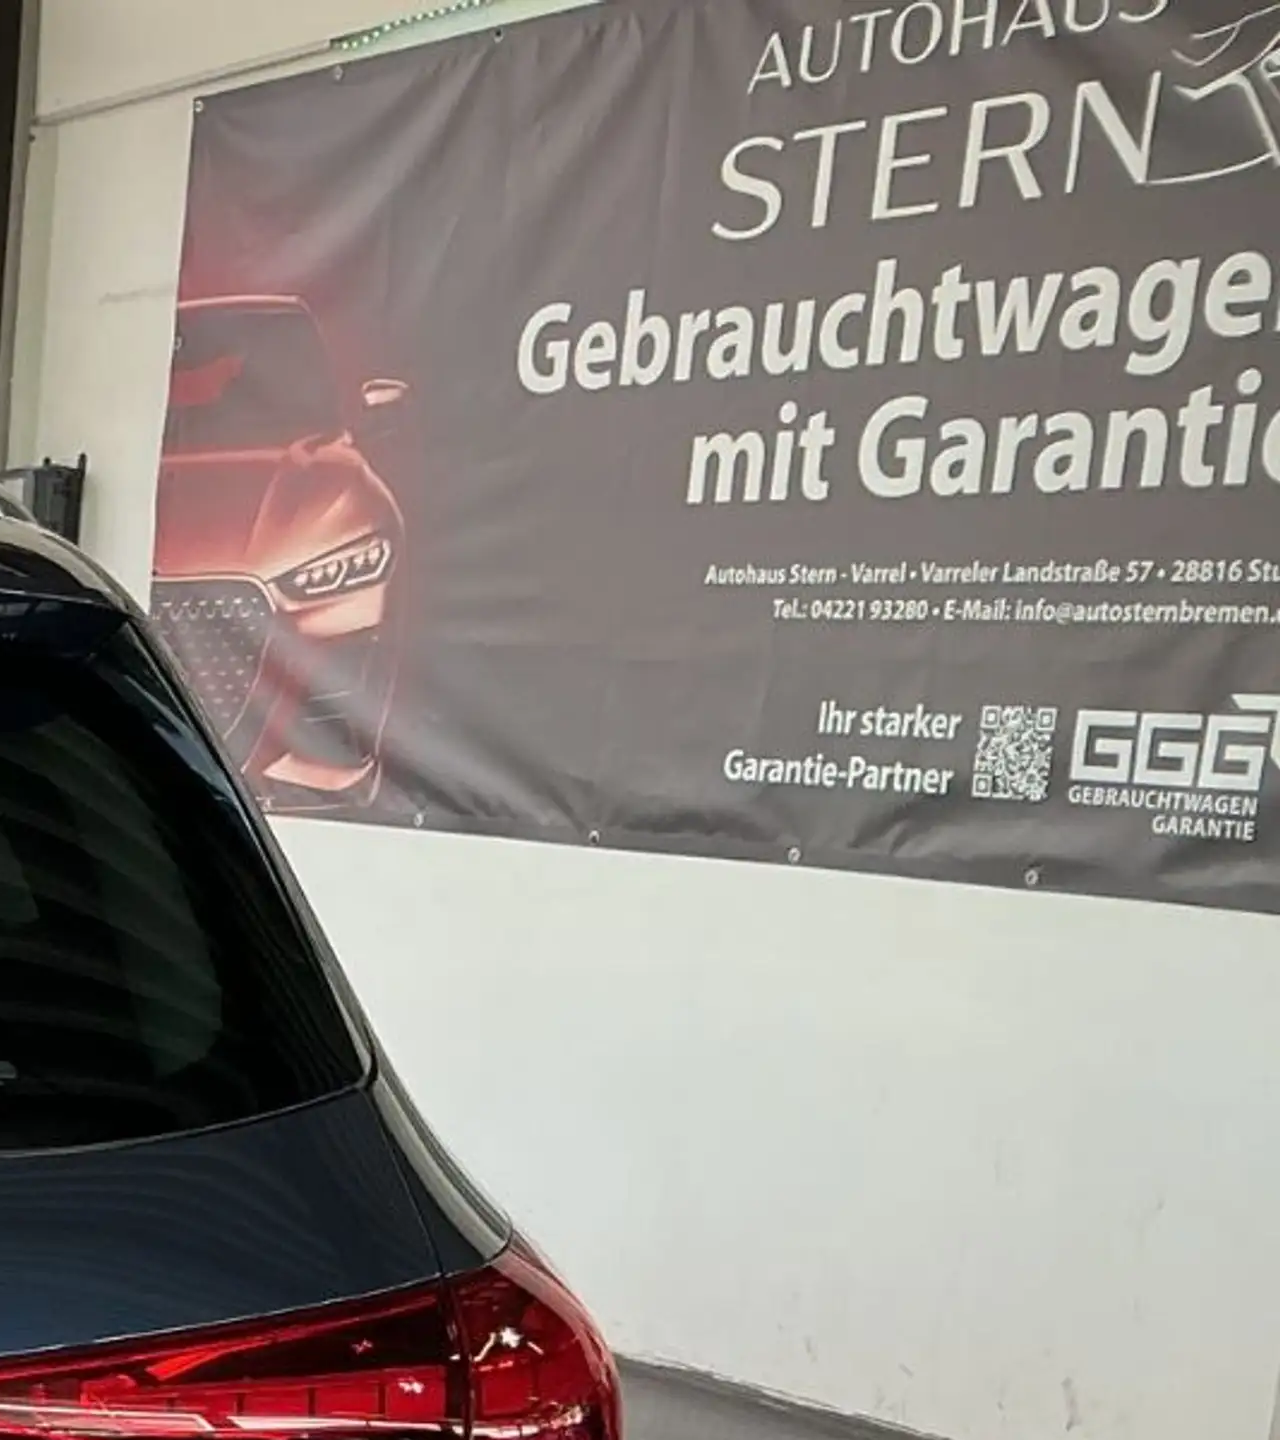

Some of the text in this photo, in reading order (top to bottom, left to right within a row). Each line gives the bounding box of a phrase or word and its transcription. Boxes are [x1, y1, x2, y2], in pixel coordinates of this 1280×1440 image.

[711, 71, 1161, 241] STERN
[517, 250, 1280, 394] Gebrauchtwage
[686, 401, 835, 504] mit
[704, 564, 786, 585] Autohaus
[790, 563, 837, 584] Stern
[851, 562, 907, 584] Varrel
[921, 561, 998, 584] Varreler
[1002, 559, 1120, 582] Landstraße
[1125, 561, 1154, 582] 57
[1170, 559, 1243, 582] 28816
[811, 600, 864, 620] 04221
[870, 600, 928, 620] 93280
[944, 599, 1010, 621] E-Mail:
[1015, 598, 1280, 624] info@autosternbremen.
[818, 700, 962, 740] Ihr starker
[1070, 708, 1273, 791] GGG
[724, 749, 954, 795] Garantie-Partner
[1068, 785, 1258, 817] GEBRAUCHTWAGEN
[1152, 815, 1255, 841] GARANTIE
